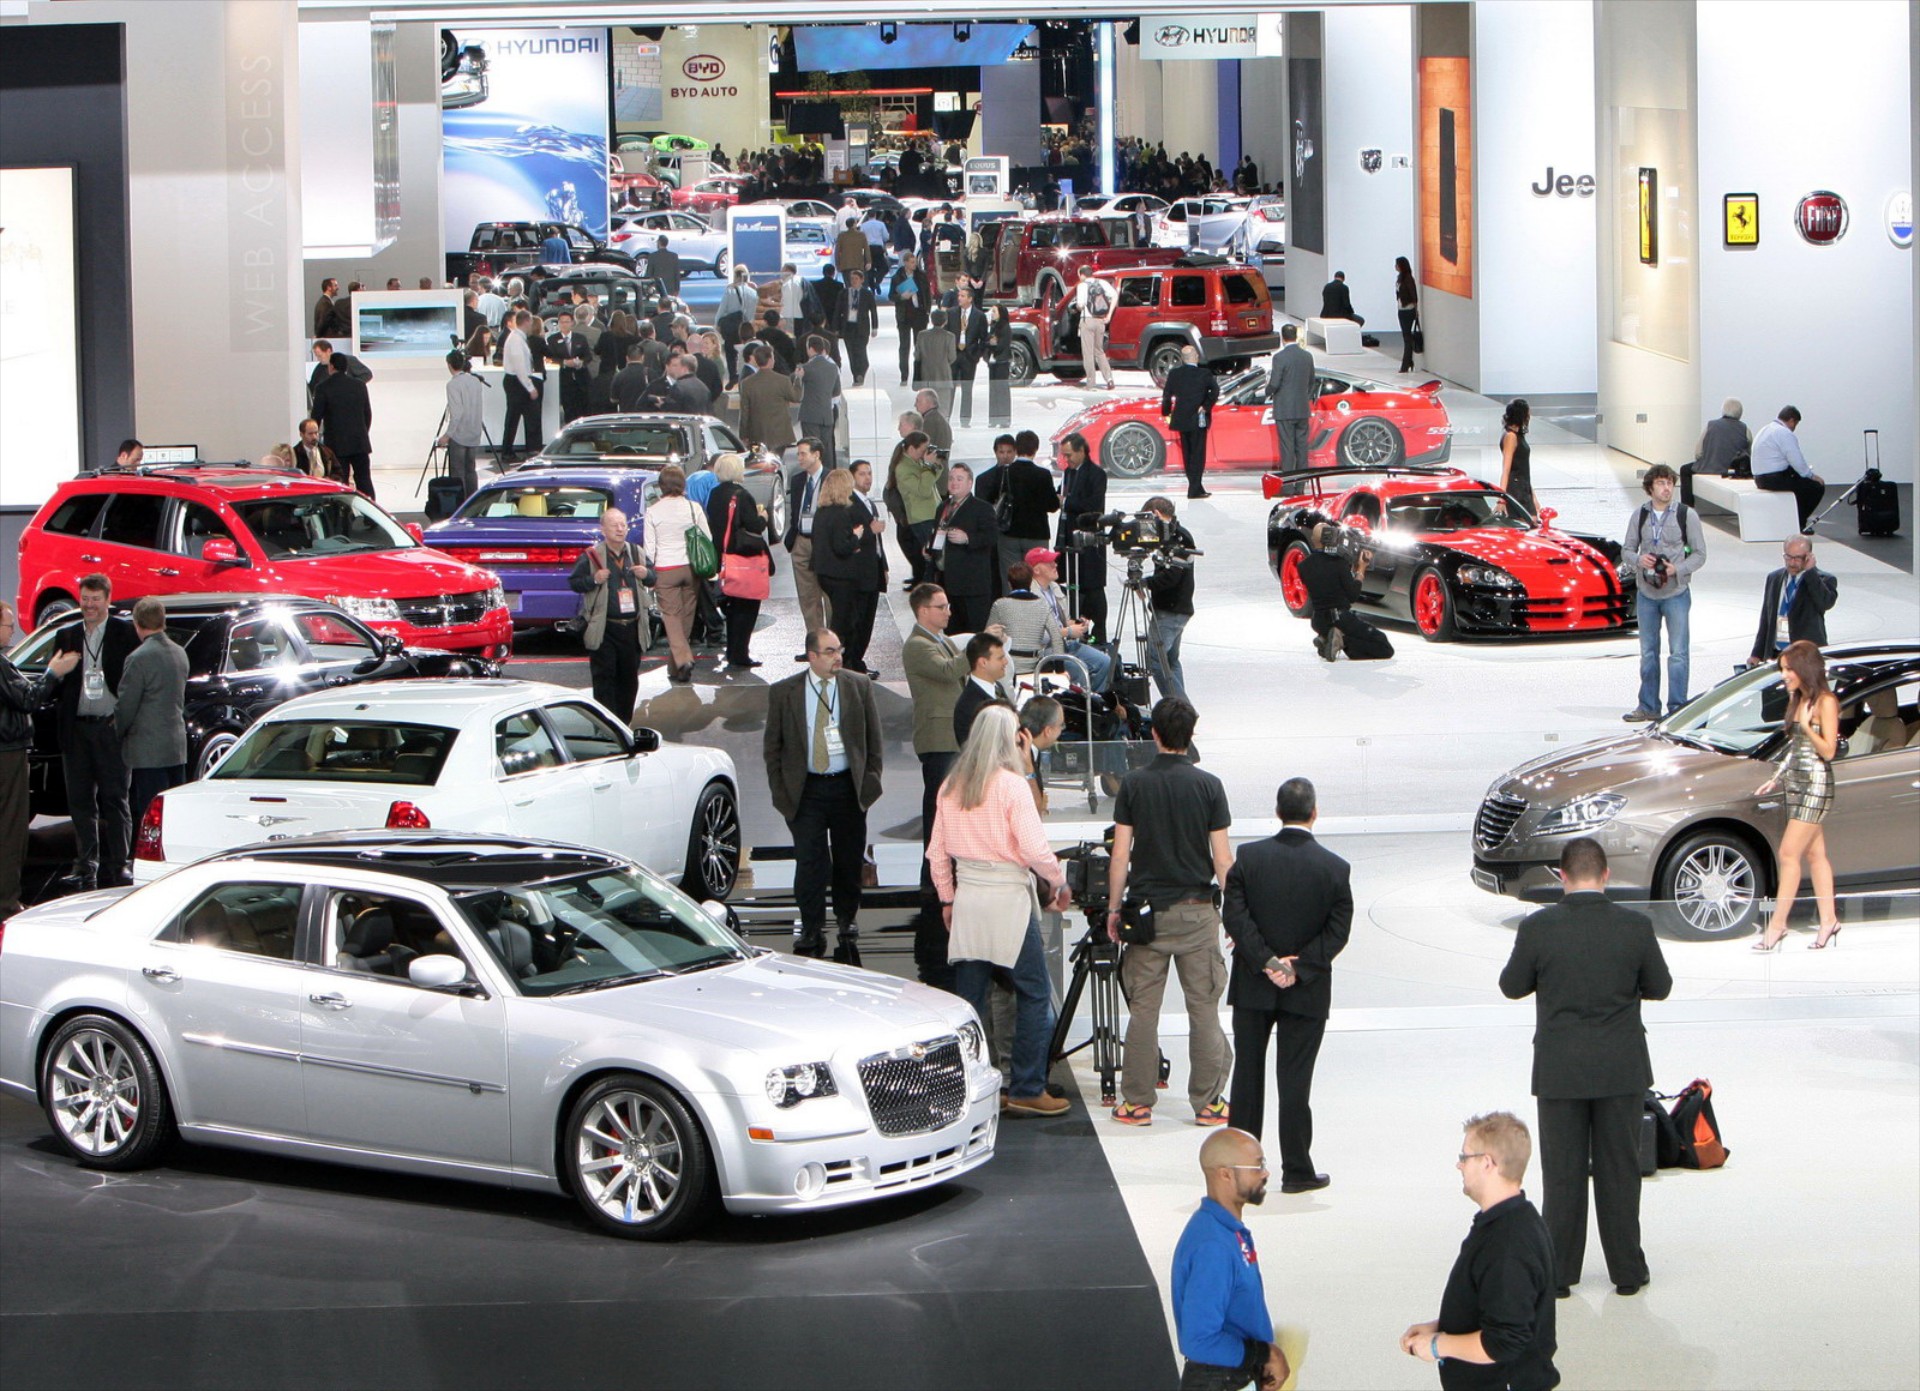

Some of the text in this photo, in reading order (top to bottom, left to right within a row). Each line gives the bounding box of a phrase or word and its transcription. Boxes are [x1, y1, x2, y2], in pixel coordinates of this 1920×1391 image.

[1193, 26, 1255, 45] HYUNDA
[497, 37, 599, 56] HYUNDAI
[688, 62, 720, 74] BYD
[671, 86, 738, 98] BYD AUTO
[1531, 166, 1596, 197] Jee
[240, 55, 275, 335] WEB ACCESS
